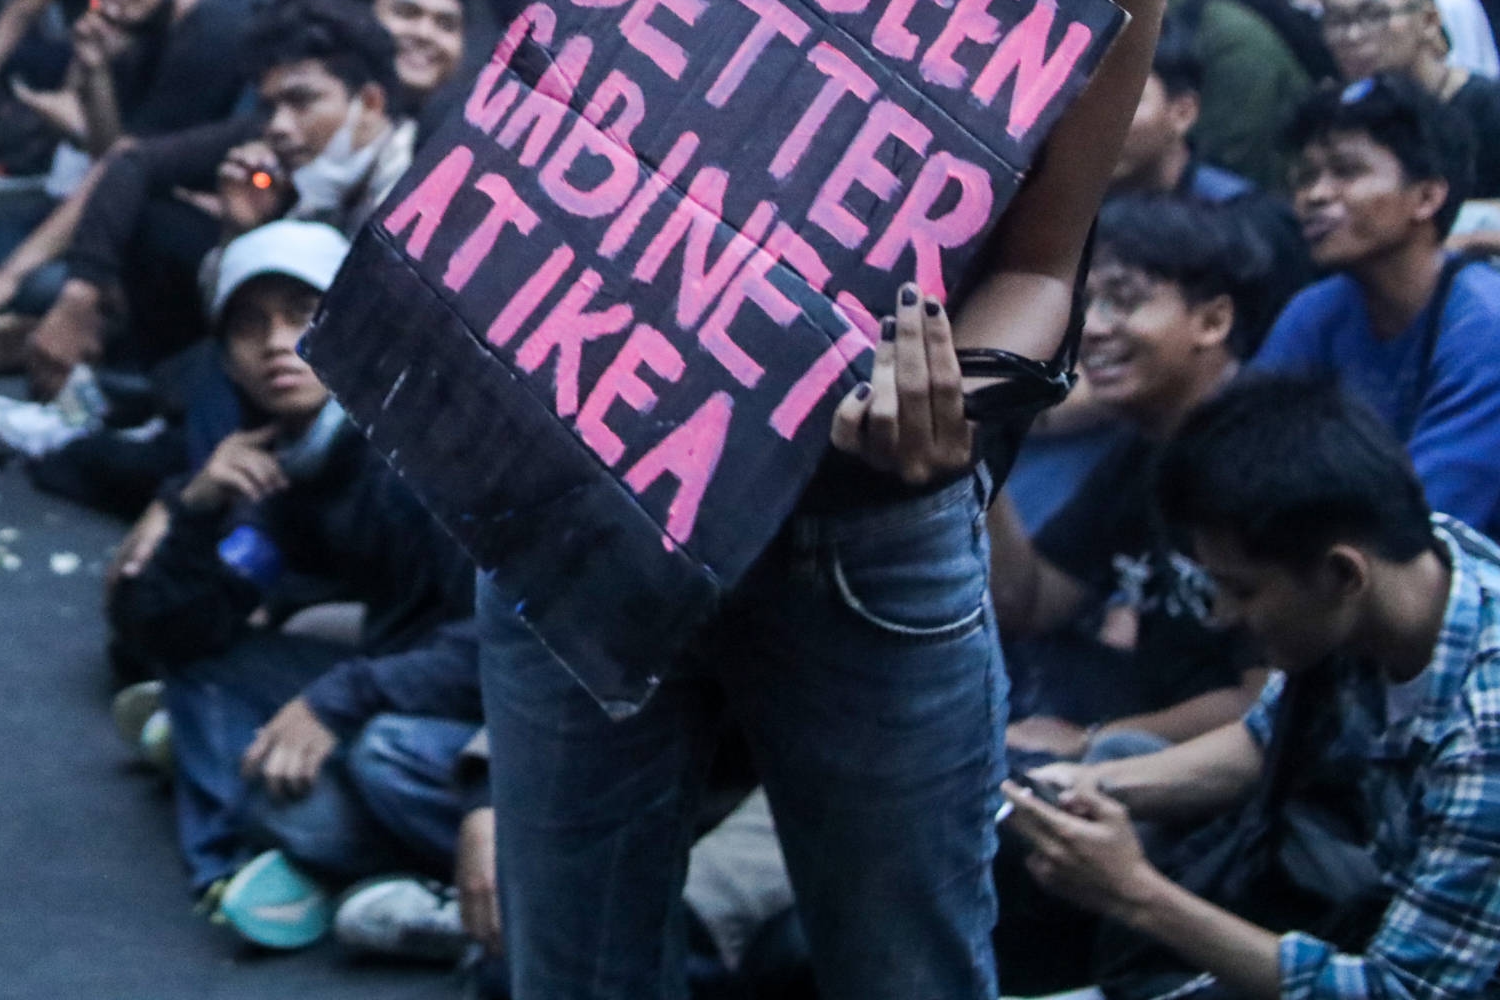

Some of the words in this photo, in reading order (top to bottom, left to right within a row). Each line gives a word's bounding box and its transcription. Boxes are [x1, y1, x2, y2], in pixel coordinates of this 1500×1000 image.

[383, 145, 540, 292] AT
[487, 243, 734, 552] IKEA
[464, 2, 880, 441] CABINET
